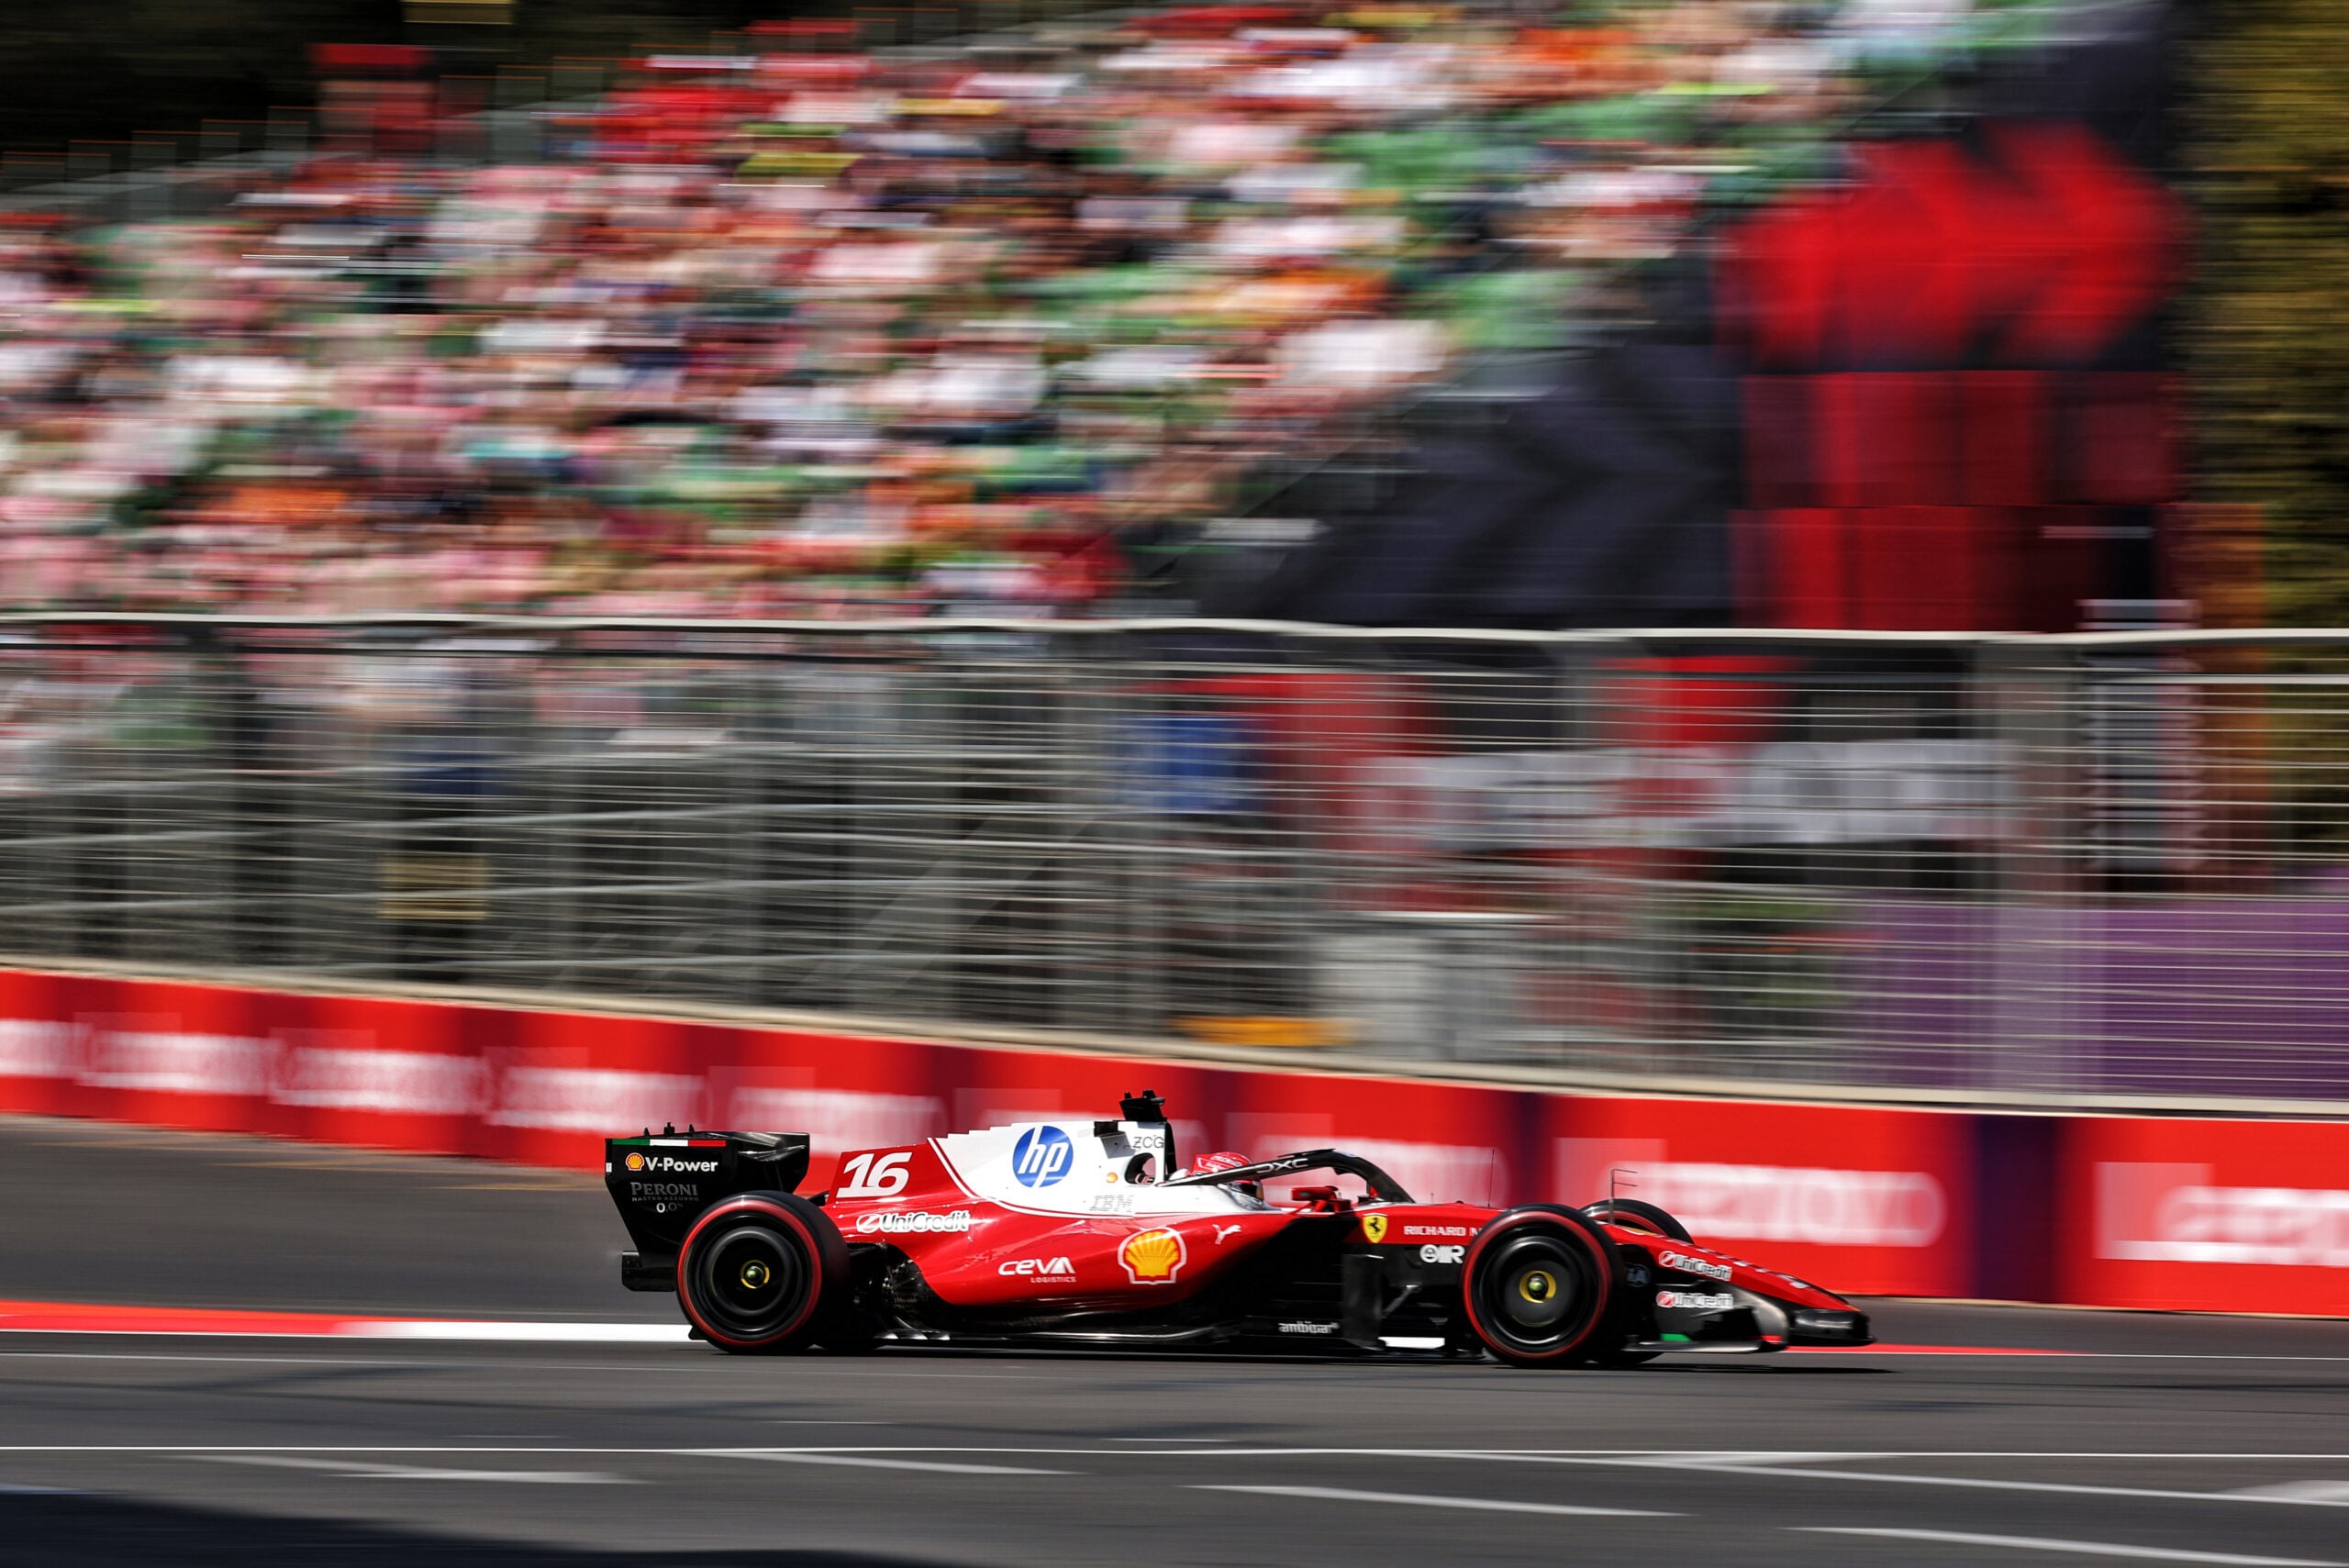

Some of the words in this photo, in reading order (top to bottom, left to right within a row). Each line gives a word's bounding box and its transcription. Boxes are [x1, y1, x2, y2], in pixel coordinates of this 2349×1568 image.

[1132, 1136, 1165, 1149] ZCG
[644, 1156, 718, 1173] V-Power
[1017, 1126, 1069, 1187] hp
[836, 1151, 913, 1198] 16
[629, 1182, 698, 1196] PERONI
[882, 1210, 970, 1233] UniCredit
[1403, 1225, 1467, 1237] RICHARD
[1674, 1254, 1733, 1282] UniCredit
